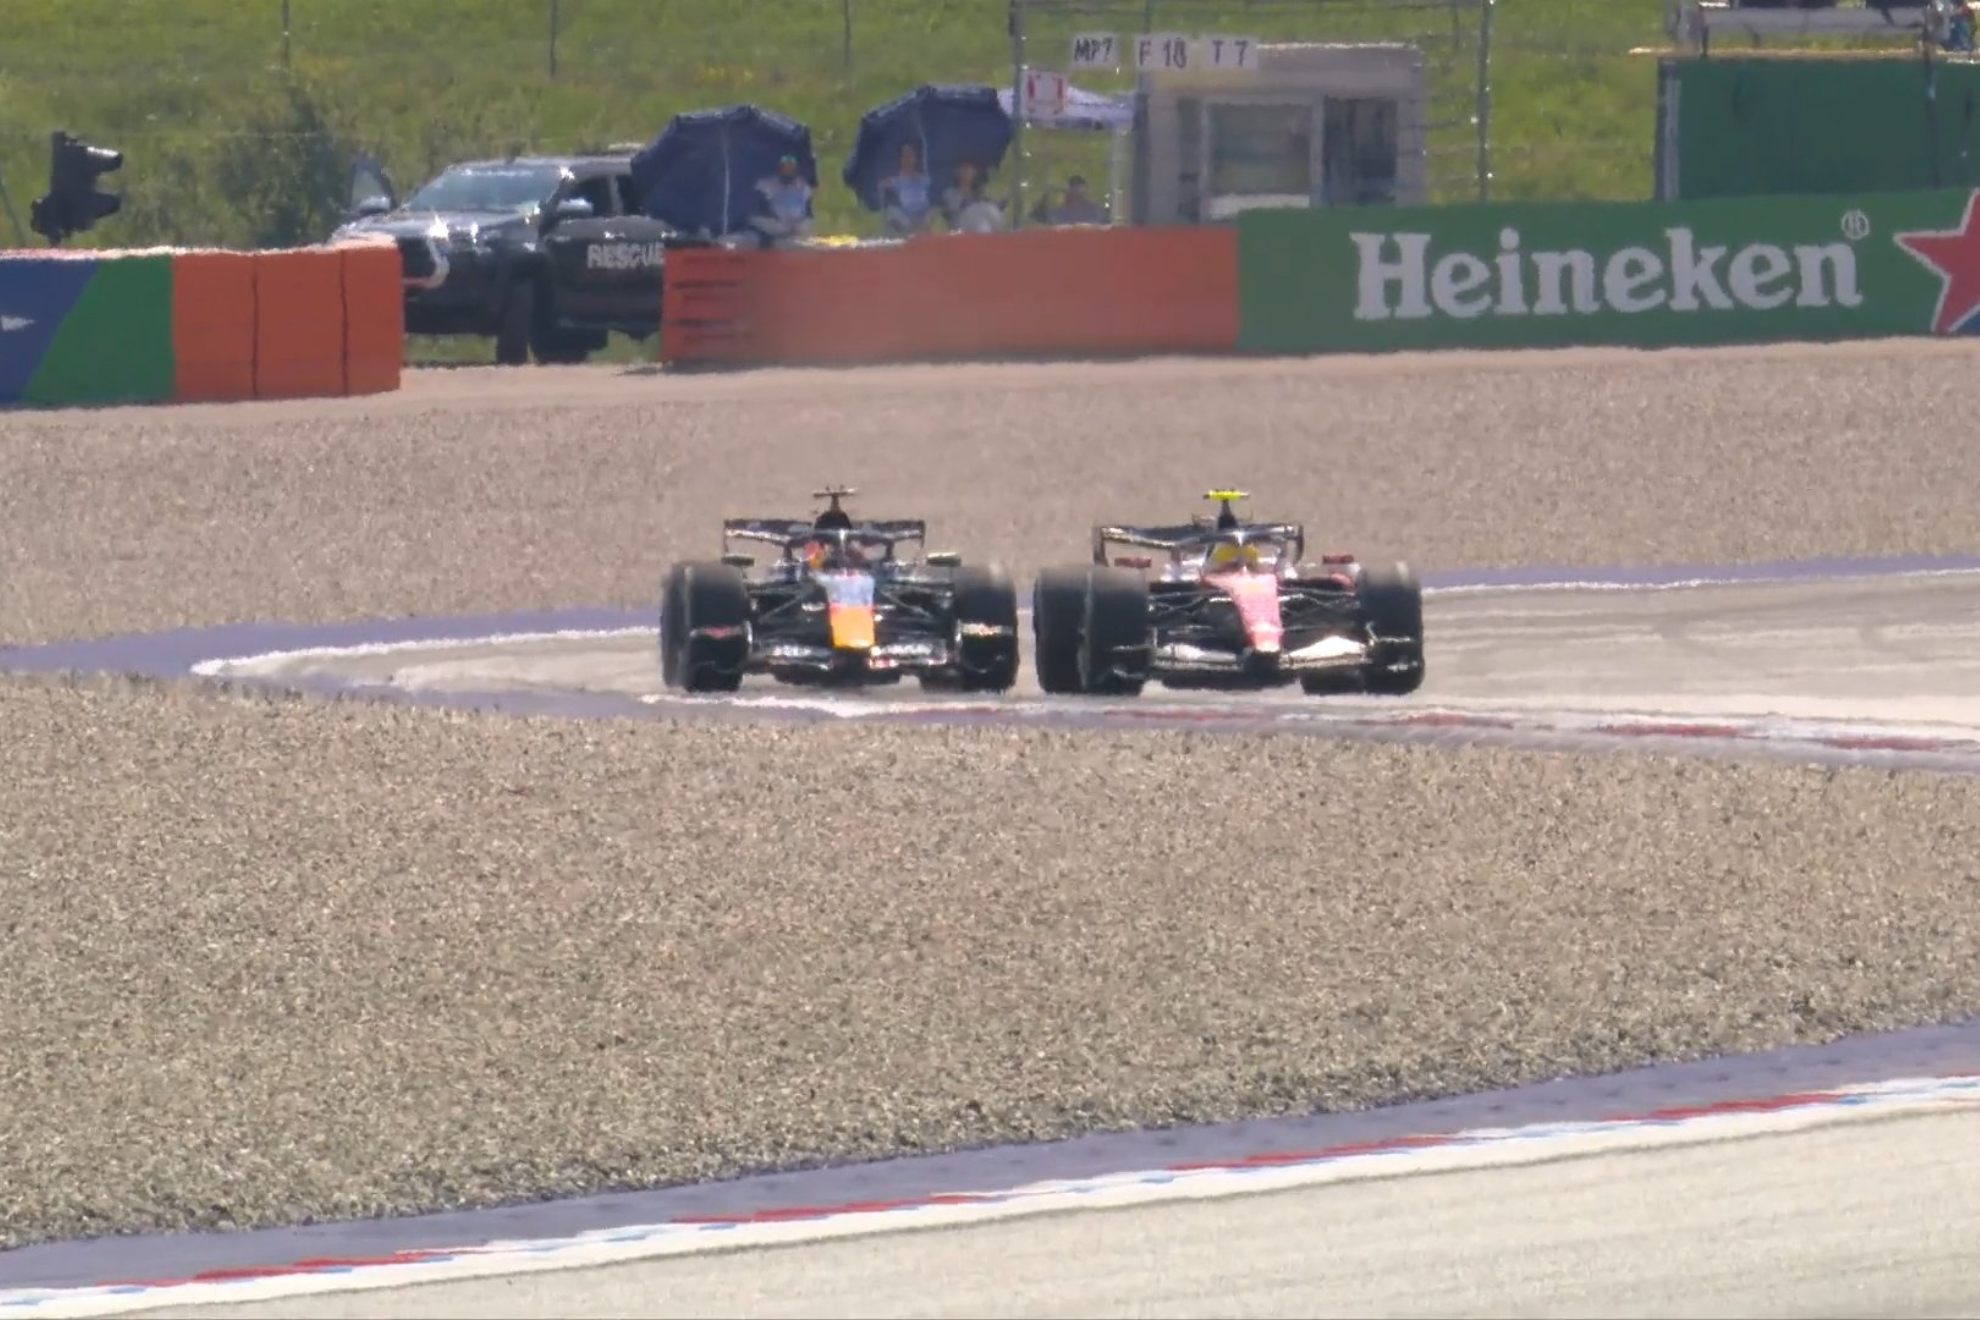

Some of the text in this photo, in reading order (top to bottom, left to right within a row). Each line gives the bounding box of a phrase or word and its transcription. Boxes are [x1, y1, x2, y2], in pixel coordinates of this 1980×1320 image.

[1212, 40, 1249, 66] T 7
[1349, 227, 1863, 319] Heineken
